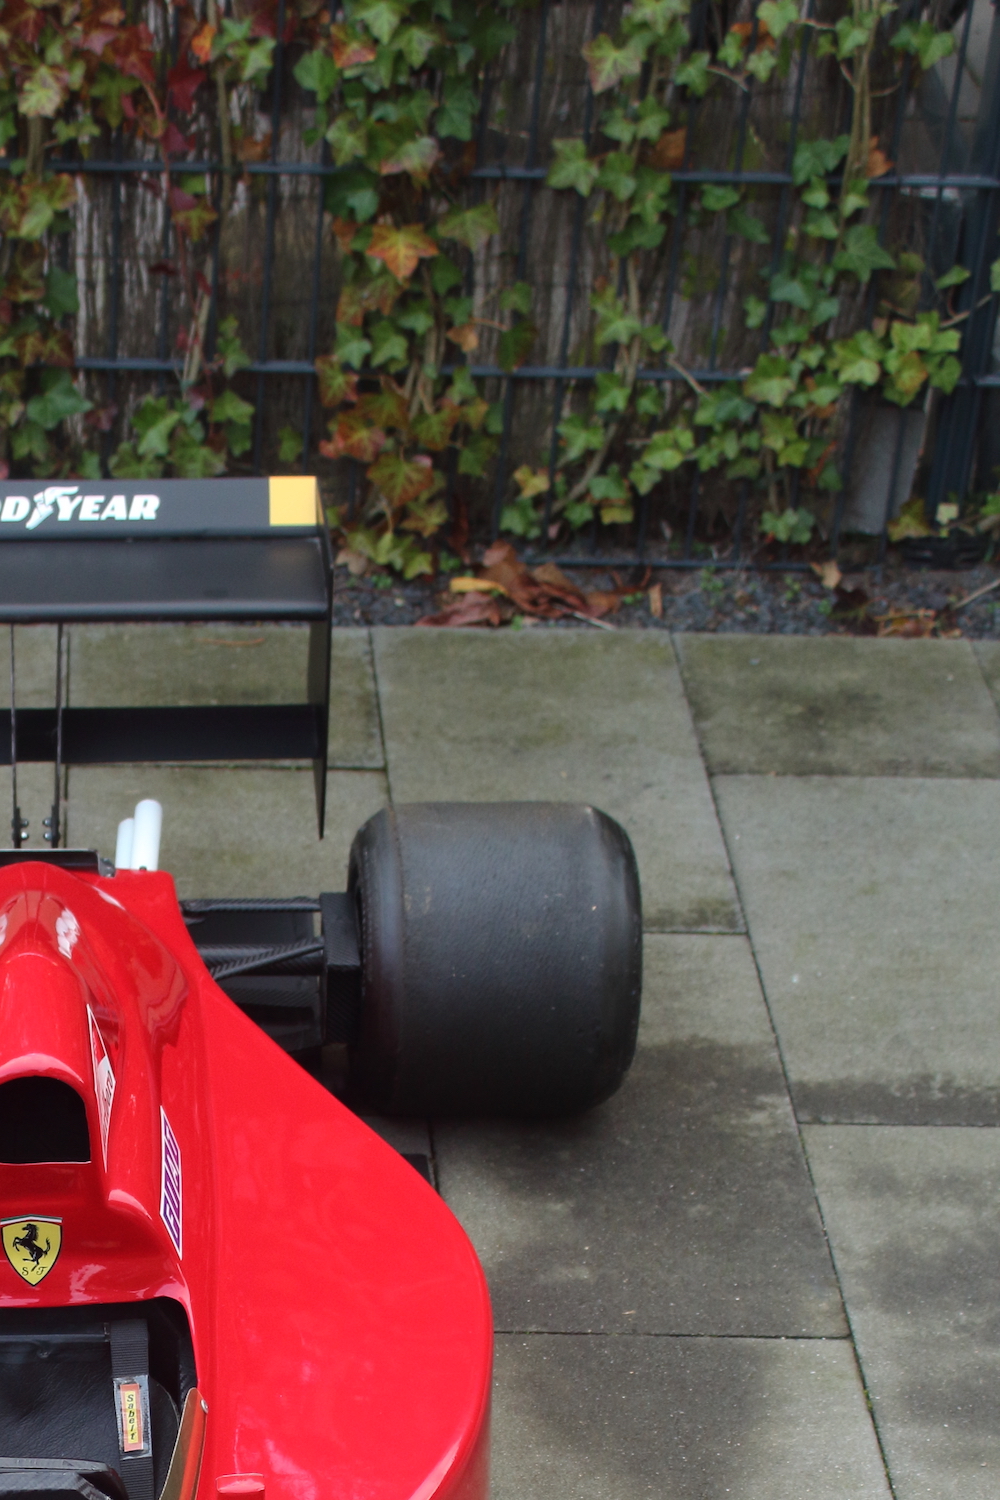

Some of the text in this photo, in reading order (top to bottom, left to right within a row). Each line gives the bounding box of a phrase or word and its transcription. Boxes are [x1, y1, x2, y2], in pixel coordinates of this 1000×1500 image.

[163, 1122, 180, 1243] FIAT
[21, 1266, 29, 1276] S
[126, 1393, 137, 1441] Sabelt
